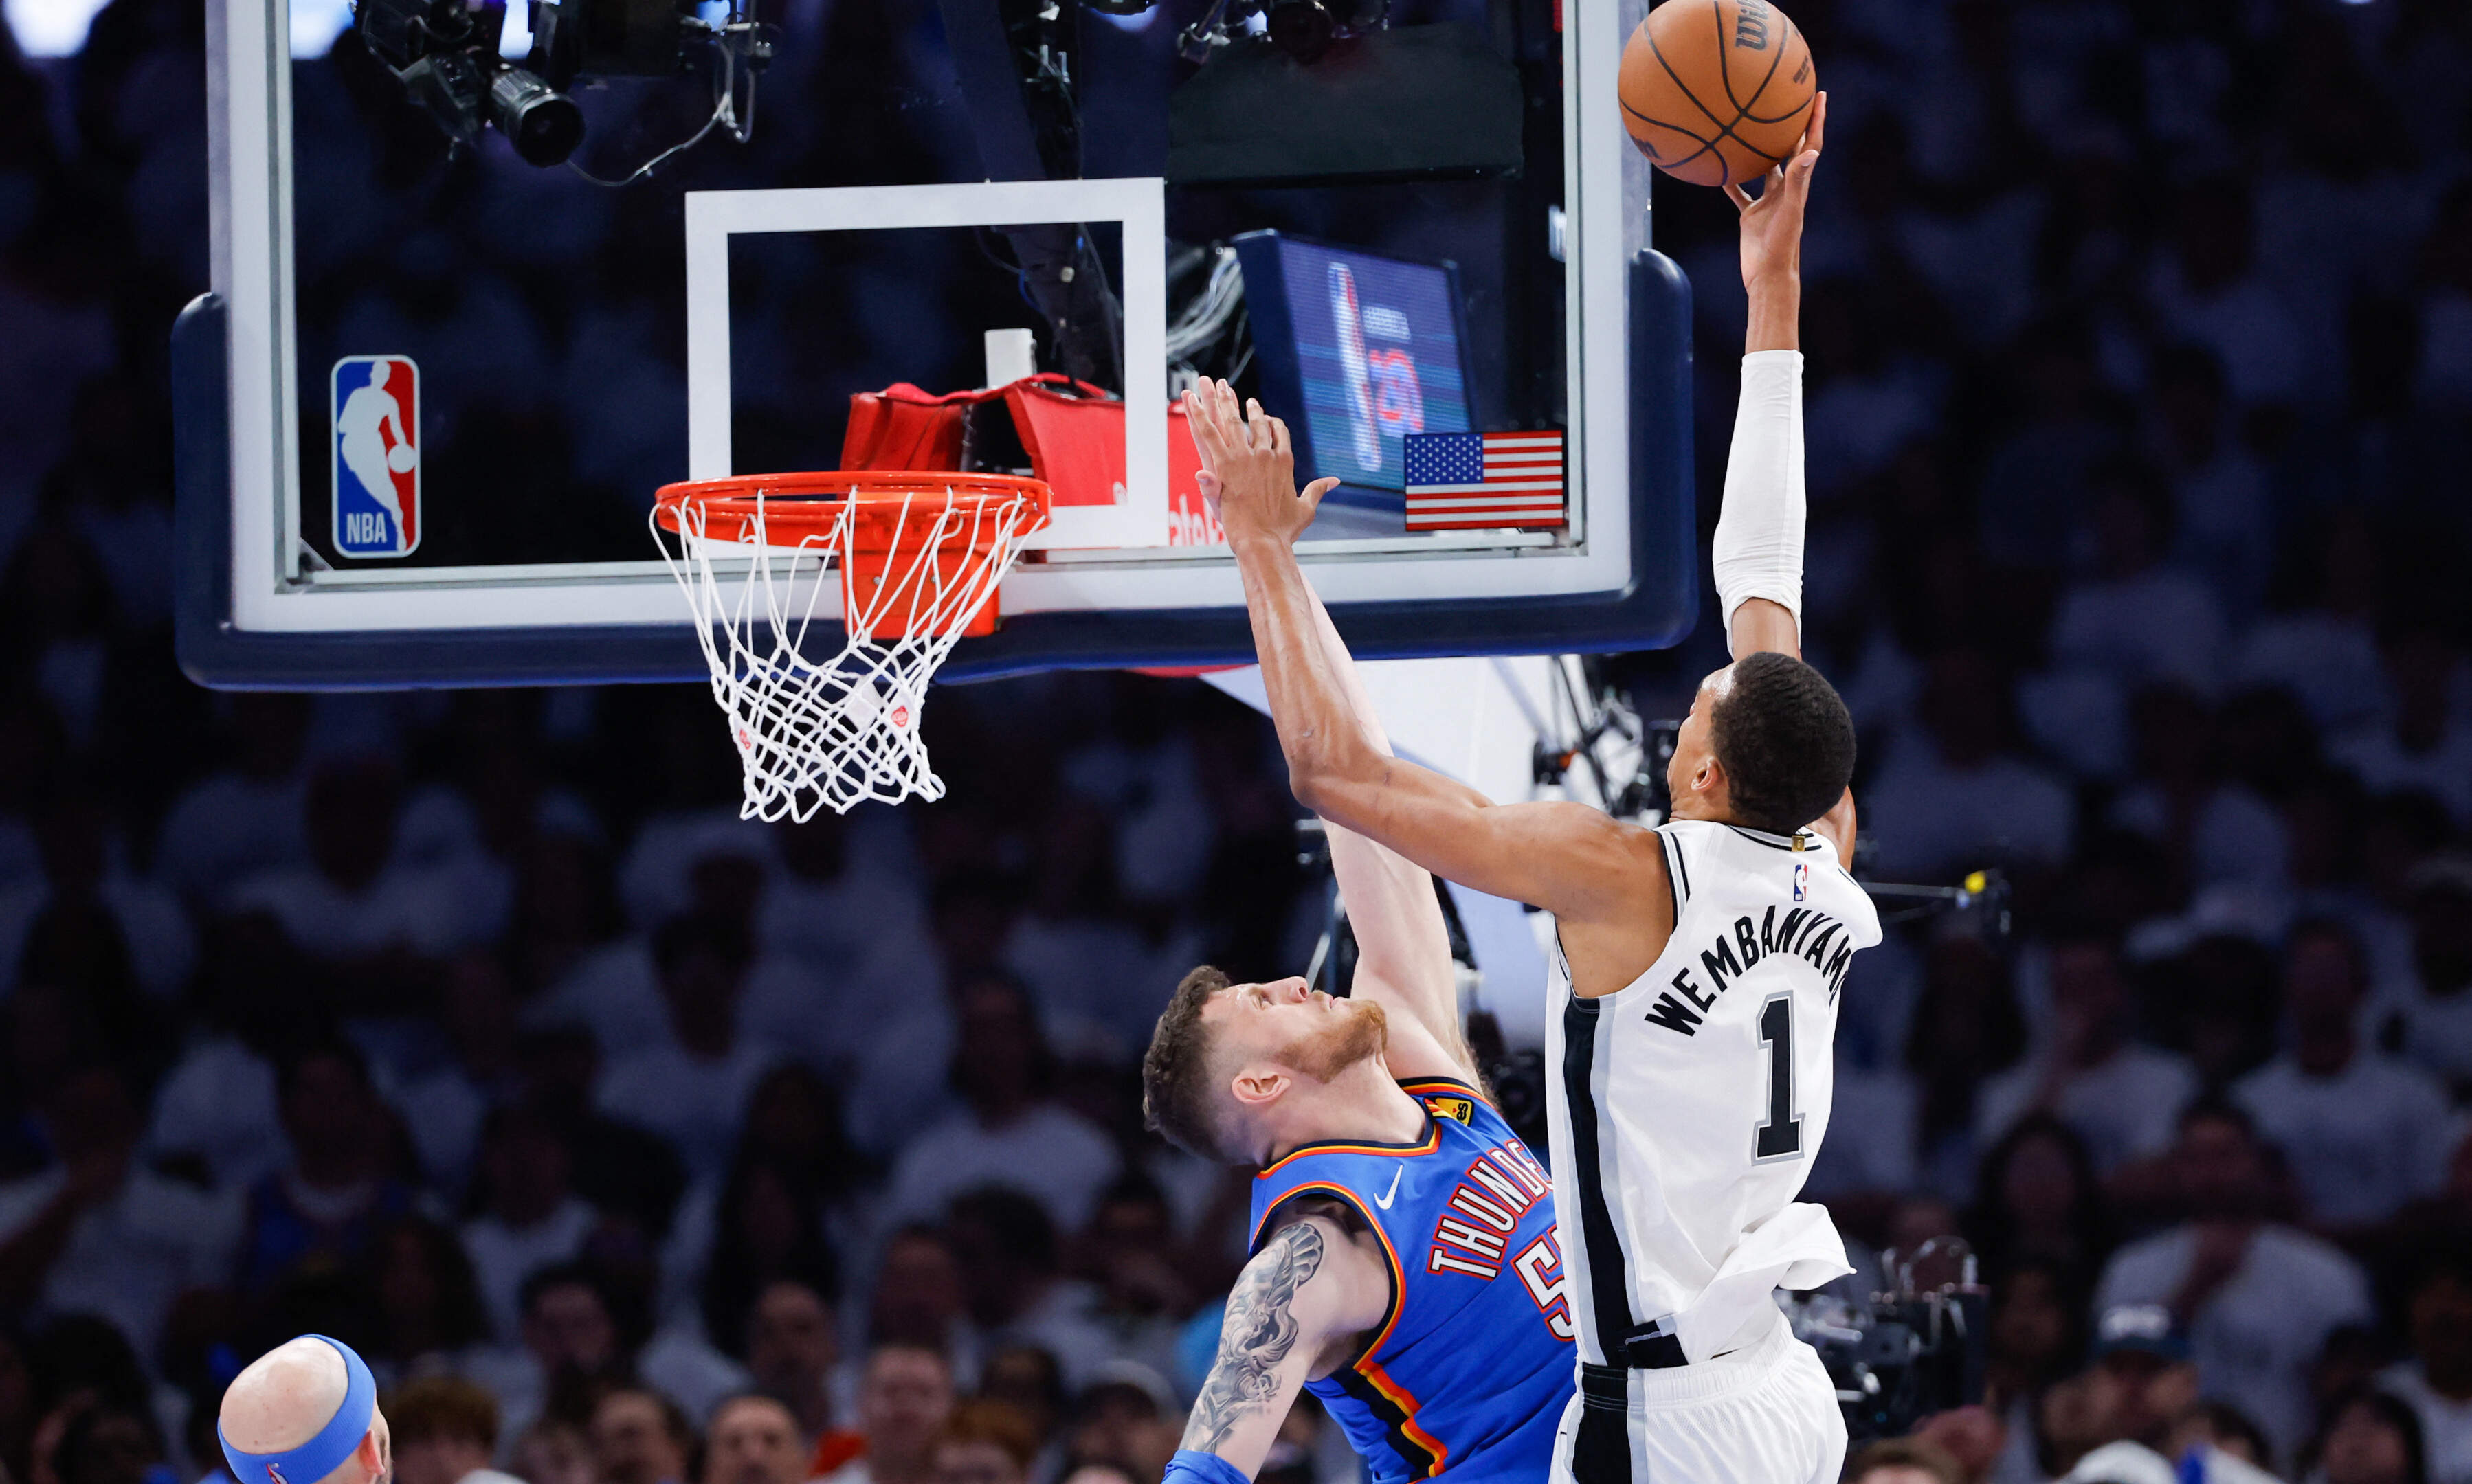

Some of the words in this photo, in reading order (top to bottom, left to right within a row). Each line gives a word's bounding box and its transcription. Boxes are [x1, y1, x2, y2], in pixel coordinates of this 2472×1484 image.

[1735, 0, 1768, 51] Wil
[346, 511, 388, 545] NBA
[1751, 989, 1805, 1166] 1
[1427, 1138, 1555, 1281] THUNDE
[1510, 1224, 1575, 1342] 5
